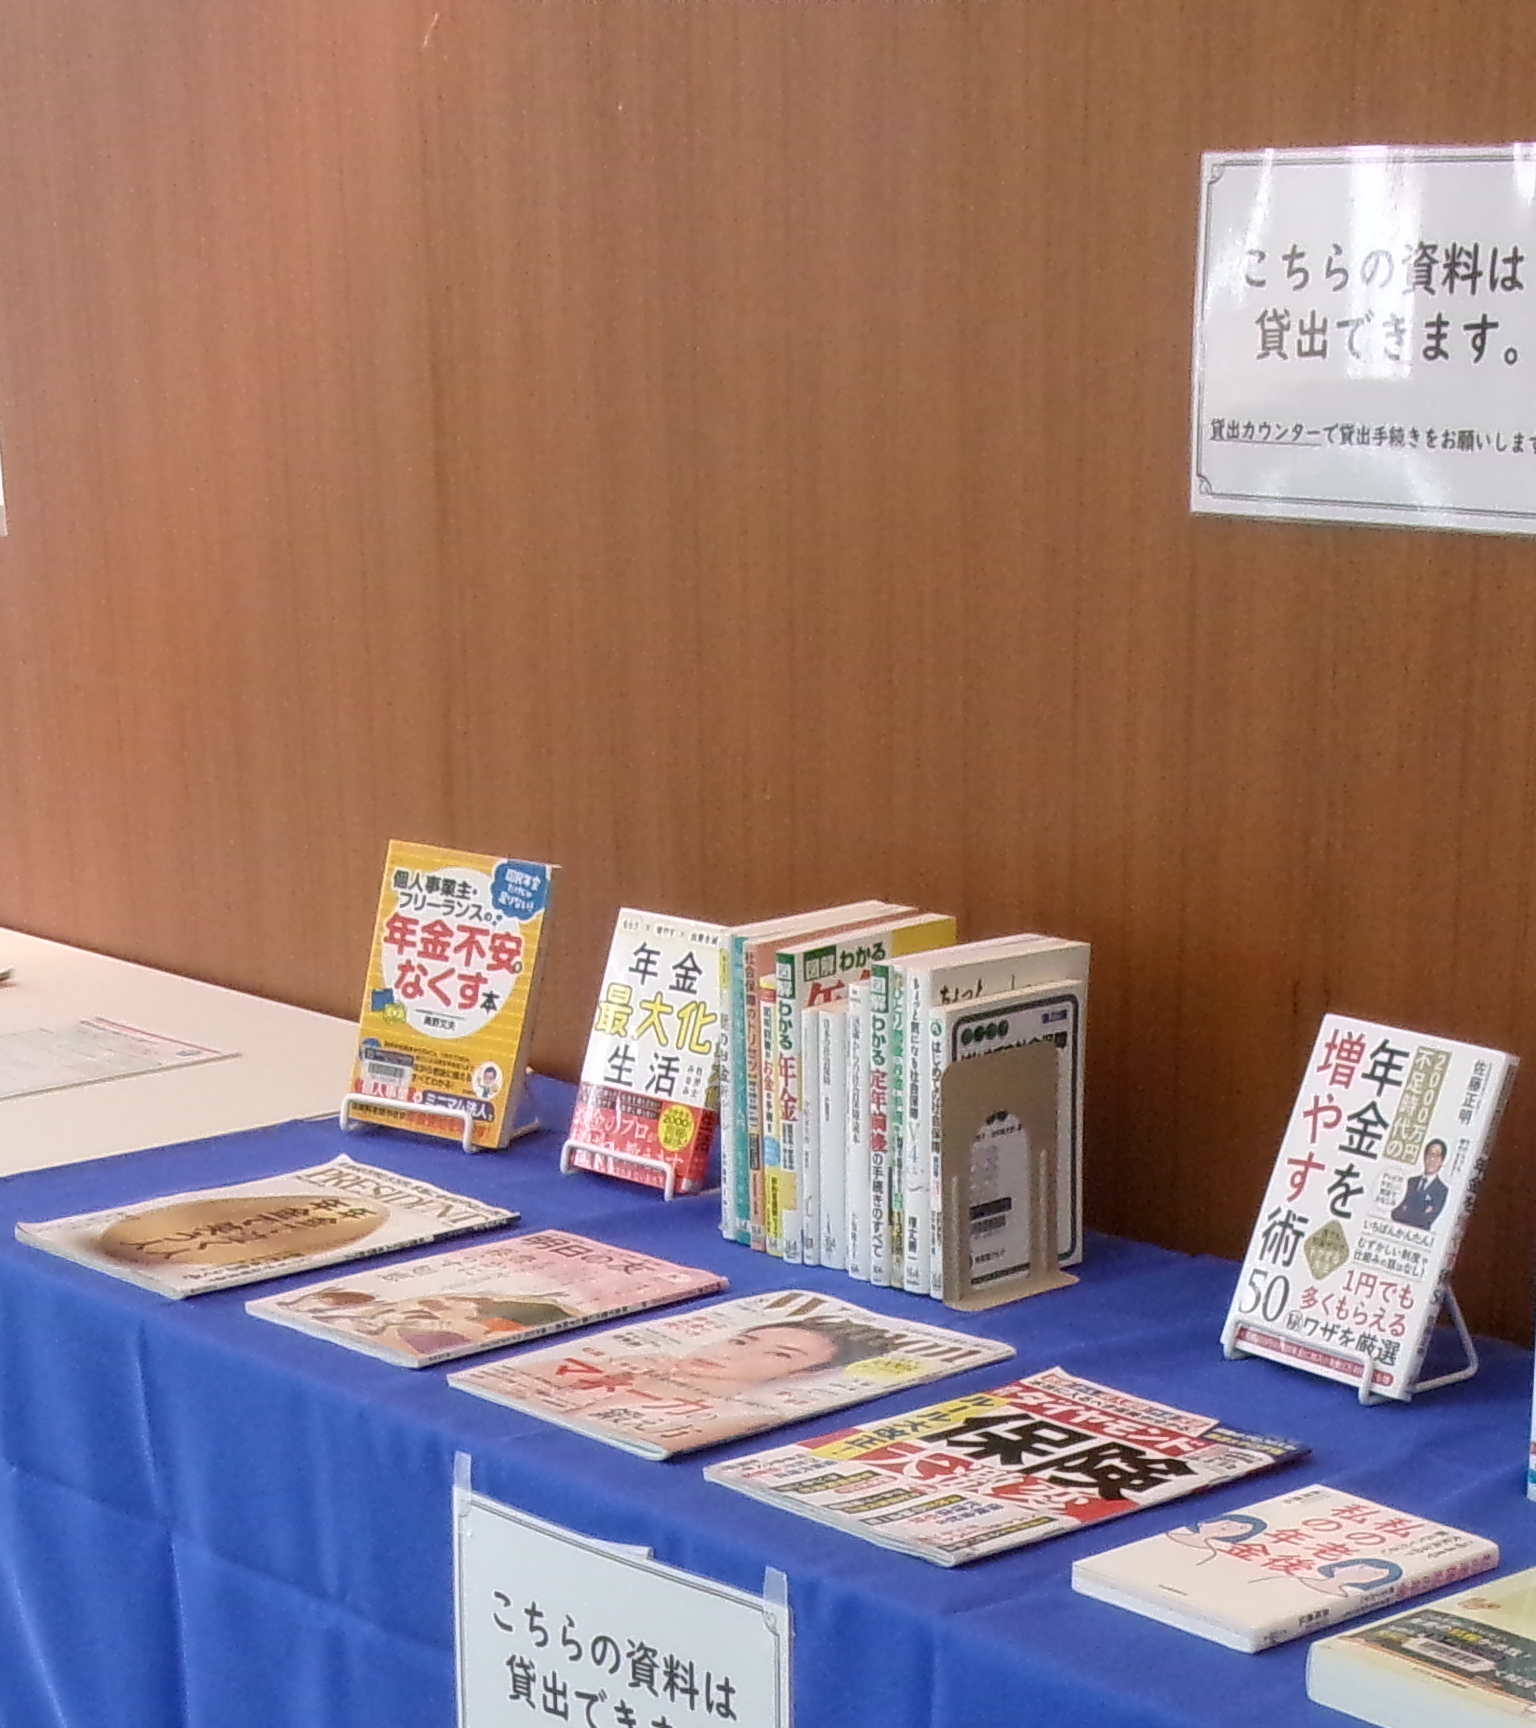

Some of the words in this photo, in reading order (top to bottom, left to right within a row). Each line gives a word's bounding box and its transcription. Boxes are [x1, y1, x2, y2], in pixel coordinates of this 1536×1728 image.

[1244, 241, 1525, 296] こちらの資料は
[1255, 308, 1519, 366] 貸出できます。
[394, 959, 500, 1014] なくす本
[629, 942, 702, 995] 年金
[840, 942, 886, 971] わかる
[595, 982, 718, 1056] 最大化
[778, 1001, 795, 1051] わかる
[871, 1015, 887, 1065] わかる
[604, 1044, 680, 1098] 生活
[777, 1051, 798, 1122] 年金
[1327, 1038, 1409, 1220] 年金を
[1385, 1050, 1434, 1160] 不足時代の
[1402, 1053, 1448, 1163] 2000万円
[304, 1167, 487, 1228] PRESIDENT
[1300, 1286, 1407, 1338] 多くもらえる
[1343, 1270, 1415, 1311] 1円でも
[1000, 1390, 1208, 1455] ダイヤモンド
[918, 1411, 1201, 1501] 保険
[1218, 1501, 1369, 1563] 私の年金
[1259, 1514, 1426, 1577] 私の老後
[491, 1590, 739, 1722] こちらの資料は
